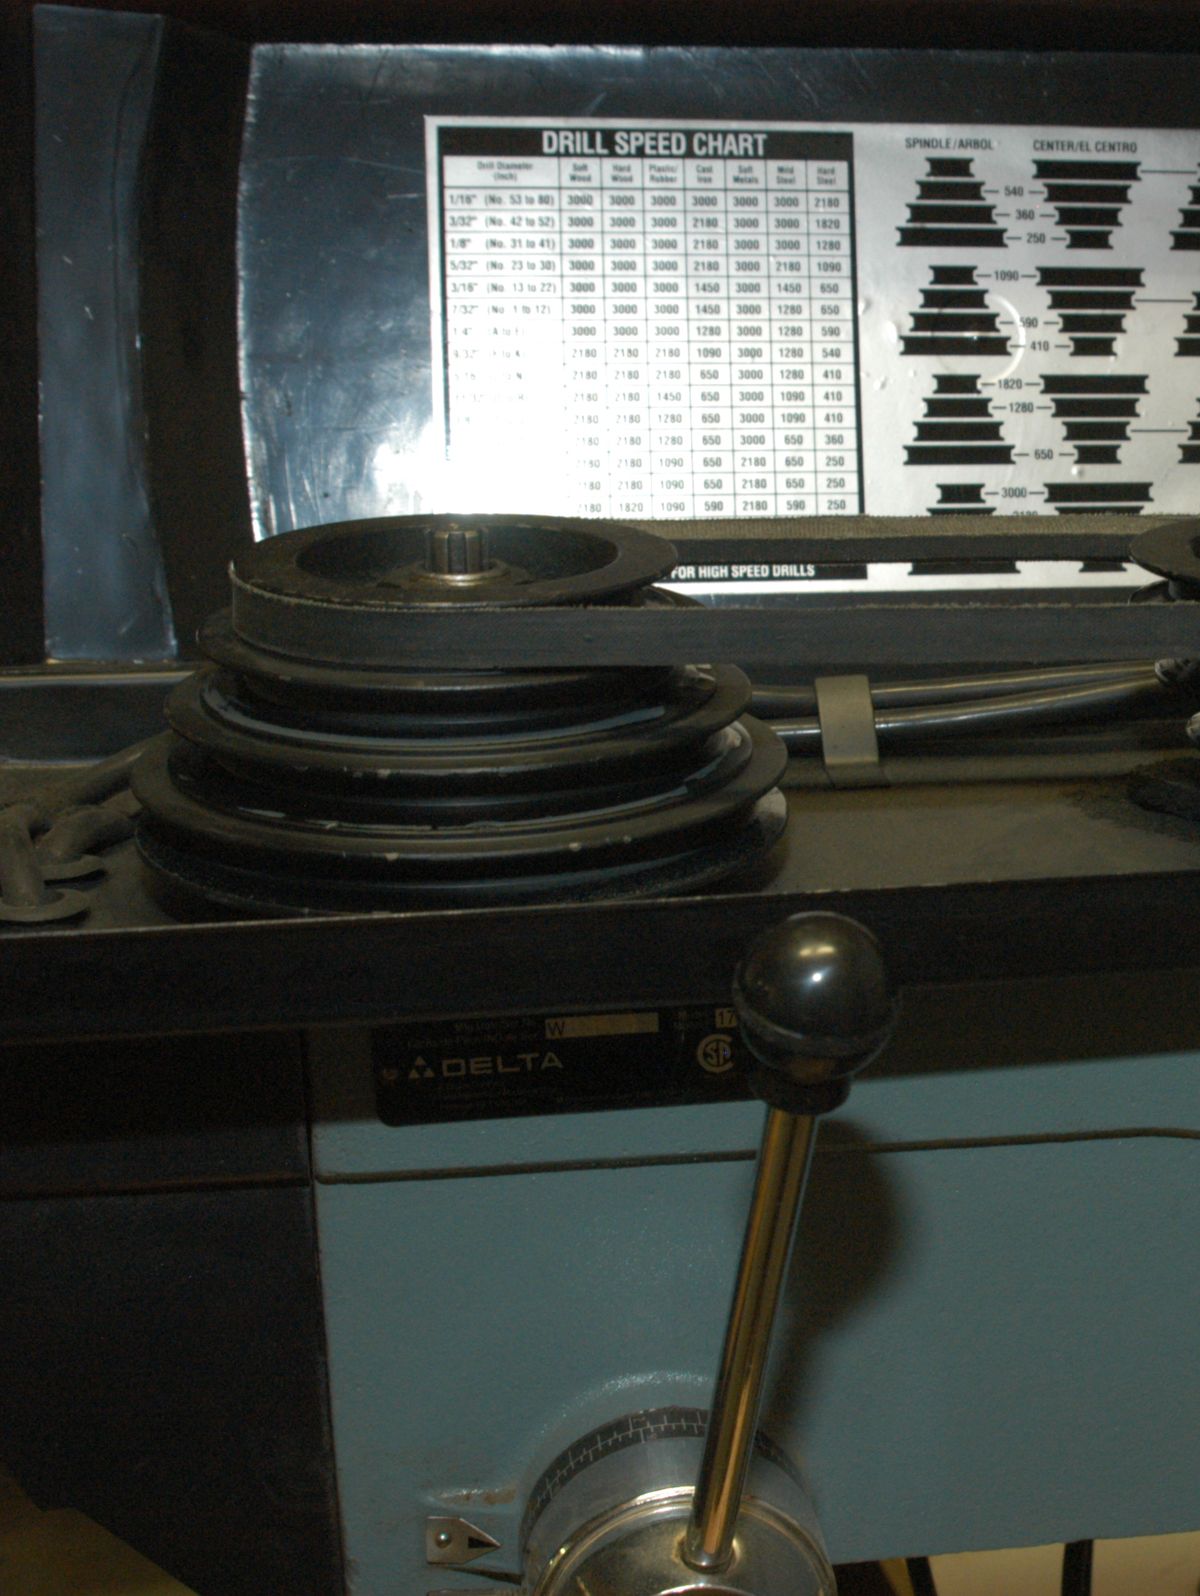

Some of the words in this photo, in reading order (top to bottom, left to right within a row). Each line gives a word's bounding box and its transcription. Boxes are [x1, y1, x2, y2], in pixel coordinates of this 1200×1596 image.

[542, 130, 609, 154] DRILL
[614, 131, 686, 155] SPEED
[692, 133, 767, 156] CHART
[905, 138, 994, 150] SPINDLE/ARBOL
[1033, 140, 1092, 152] CENTER/EL
[1095, 141, 1138, 153] CENTRO
[1004, 186, 1024, 198] 540
[524, 195, 535, 205] to
[568, 194, 593, 205] 3000
[610, 195, 635, 206] 3000
[652, 195, 676, 206] 3000
[693, 196, 717, 206] 3000
[734, 196, 758, 207] 3000
[775, 197, 799, 207] 3000
[815, 197, 840, 208] 2180
[1015, 209, 1035, 220] 360
[510, 216, 523, 226] 42
[525, 217, 535, 227] to
[568, 217, 594, 227] 3000
[610, 217, 636, 227] 3000
[652, 217, 677, 227] 3000
[693, 217, 718, 228] 2180
[735, 218, 759, 228] 3000
[775, 218, 800, 229] 3000
[816, 219, 840, 229] 1820
[1026, 232, 1046, 244] 250
[510, 238, 523, 248] 31
[525, 239, 536, 248] to
[538, 238, 556, 250] 41)
[569, 239, 594, 249] 3000
[611, 239, 636, 249] 3000
[652, 239, 678, 249] 3000
[694, 239, 719, 250] 2180
[735, 240, 759, 250] 3000
[776, 240, 800, 250] 3000
[817, 240, 841, 251] 1280
[994, 270, 1019, 281] 1090
[697, 326, 721, 336] 1280
[737, 326, 762, 336] 3000
[779, 326, 803, 336] 1280
[822, 326, 840, 336] 590
[1030, 341, 1050, 352] 410
[698, 348, 721, 358] 1090
[738, 348, 762, 358] 3000
[779, 348, 803, 358] 1280
[822, 348, 841, 358] 540
[700, 370, 719, 379] 650
[739, 370, 763, 379] 3000
[780, 369, 804, 380] 1280
[823, 370, 842, 380] 410
[997, 379, 1022, 390] 1820
[701, 392, 719, 401] 650
[739, 391, 764, 401] 3000
[781, 391, 805, 401] 1090
[824, 391, 842, 401] 410
[1009, 402, 1034, 413] 1280
[702, 413, 720, 423] 650
[740, 413, 764, 423] 3000
[782, 413, 805, 423] 1090
[824, 413, 843, 423] 410
[702, 435, 721, 445] 650
[741, 435, 765, 445] 3000
[784, 435, 803, 445] 650
[826, 434, 844, 445] 360
[1034, 449, 1053, 460] 650
[703, 457, 722, 467] 650
[741, 457, 766, 467] 2180
[785, 456, 804, 467] 650
[826, 456, 844, 467] 250
[704, 479, 722, 489] 650
[742, 479, 767, 489] 2180
[786, 478, 805, 488] 650
[827, 478, 845, 488] 250
[1001, 487, 1027, 498] 3000
[705, 501, 723, 511] 590
[743, 501, 768, 511] 2180
[787, 500, 805, 510] 590
[828, 499, 846, 510] 250
[698, 565, 728, 578] HIGH
[731, 565, 769, 578] SPEED
[772, 564, 815, 577] DRILLS
[442, 1052, 564, 1077] DELTA
